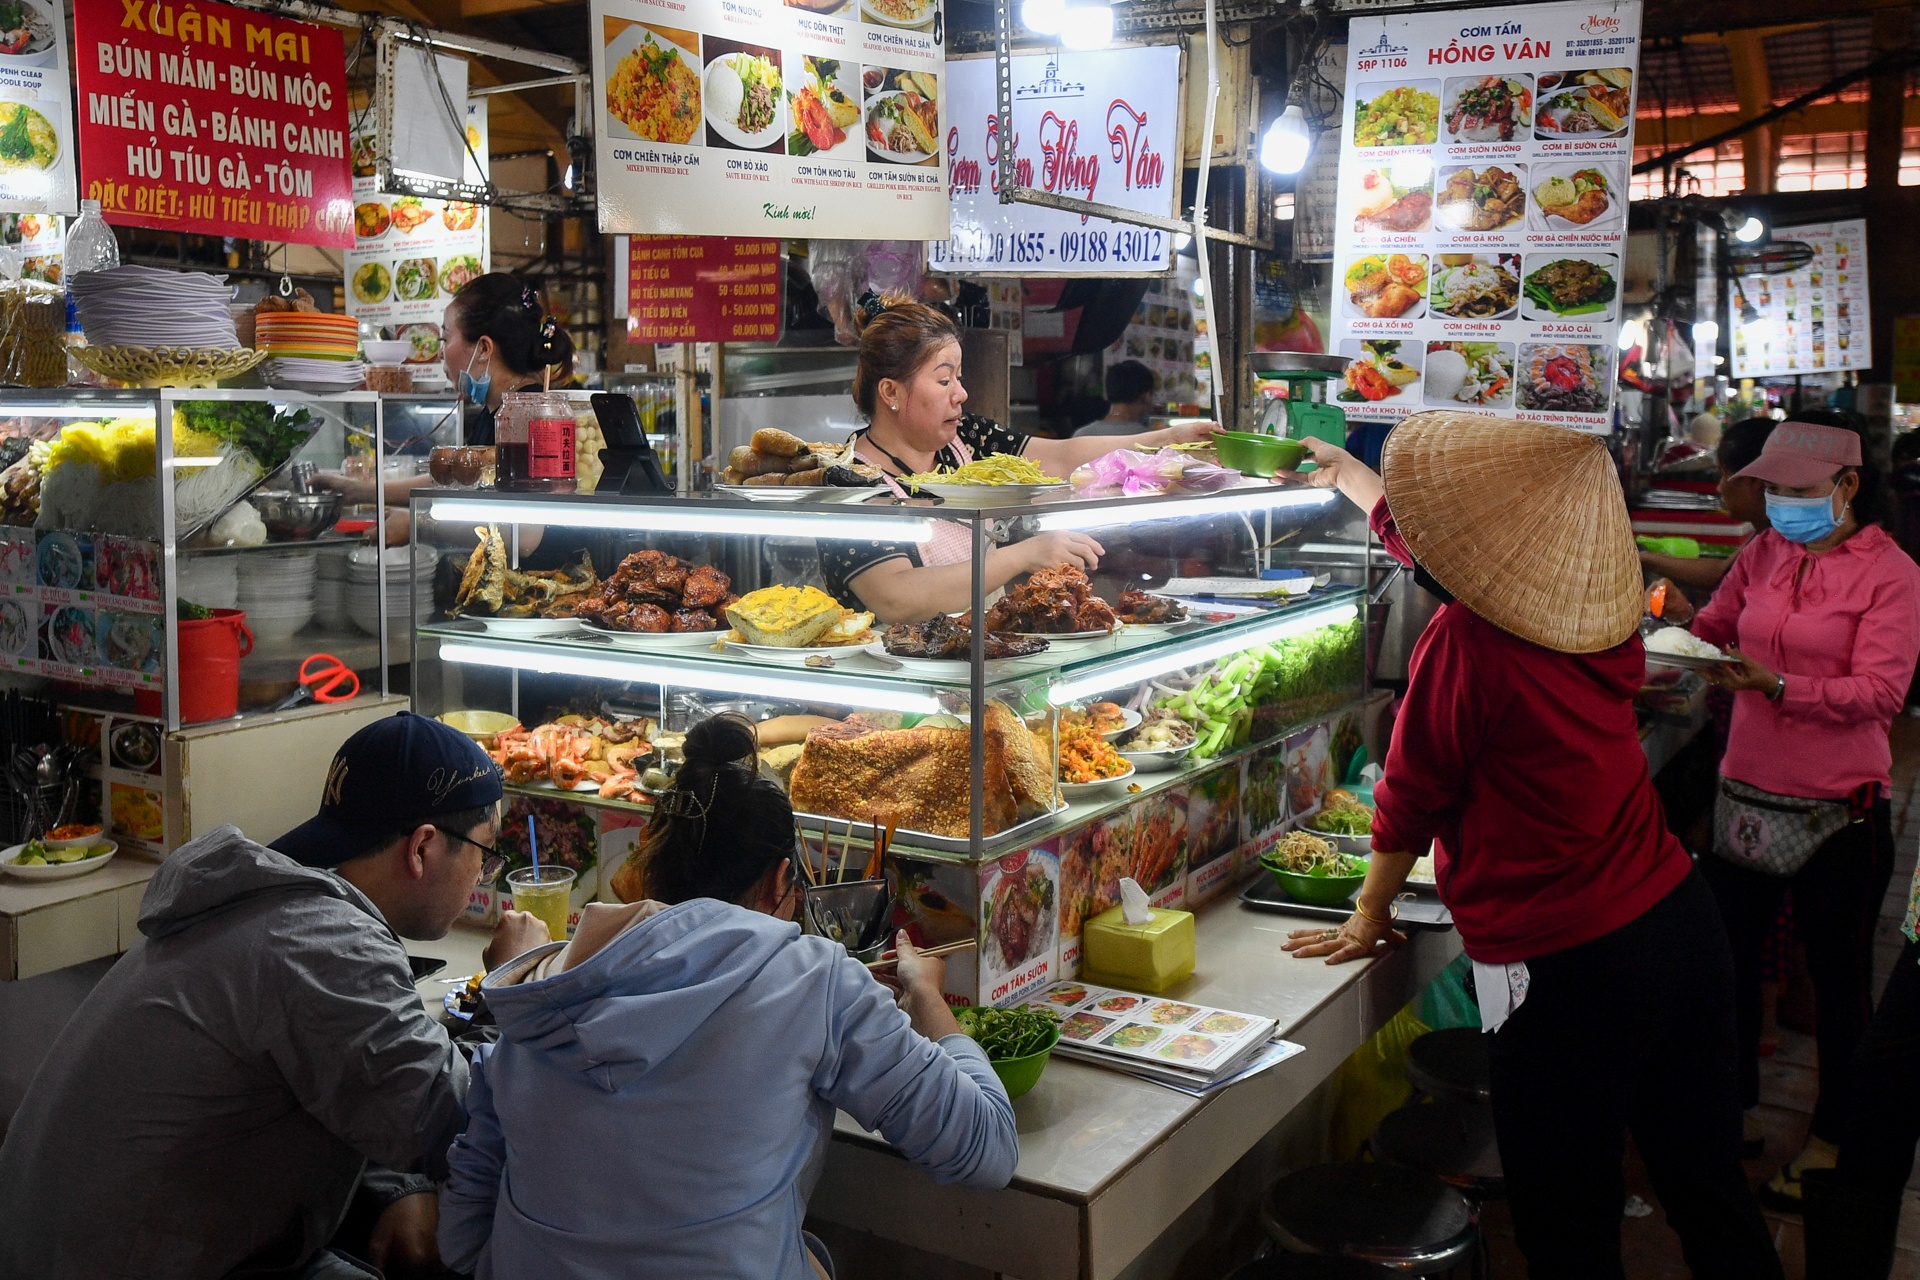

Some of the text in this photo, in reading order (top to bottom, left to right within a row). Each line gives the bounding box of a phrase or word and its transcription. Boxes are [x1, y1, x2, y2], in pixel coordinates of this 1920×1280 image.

[121, 0, 311, 64] XUÂN MAI
[1460, 21, 1522, 39] CƠM TẤM
[868, 31, 882, 42] CƠM
[883, 33, 903, 45] CHIÊN
[1428, 37, 1552, 66] HỒNG VÂN
[1358, 57, 1407, 73] SẠP 1106
[21, 69, 43, 79] CLEAR
[98, 38, 151, 81] BÚN
[284, 72, 333, 117] MỘC
[23, 79, 42, 88] SOUP
[88, 89, 156, 132] MIẾN
[283, 122, 345, 159] CANH
[1107, 98, 1164, 191] Vân
[1447, 143, 1522, 154] CƠM SƯỜN NƯỚNG
[1542, 143, 1562, 151] CƠM
[127, 137, 163, 180] HỦ
[170, 146, 211, 186] TÍU
[613, 149, 633, 161] CƠM
[634, 149, 660, 163] CHIÊN
[661, 151, 682, 166] THẬP
[626, 164, 690, 176] MIXED WITH FRIED RICE
[726, 159, 769, 172] CƠM BÒ XÀO
[797, 166, 856, 179] CƠM TÔM KHO TÀU
[868, 171, 883, 181] CƠM
[189, 188, 215, 219] HỦ
[222, 192, 261, 225] TIẾU
[267, 200, 310, 234] THẬP
[1393, 234, 1417, 243] CHIÊN
[1452, 234, 1505, 243] CƠM GÀ KHO
[1526, 234, 1545, 242] CƠM
[1545, 234, 1556, 242] GÀ
[1557, 233, 1579, 242] CHIÊN
[1009, 232, 1045, 263] 1855
[1060, 231, 1109, 263] 09188
[1112, 230, 1162, 263] 43012
[733, 284, 759, 296] 60.000
[733, 324, 759, 336] 60.000
[1353, 321, 1371, 329] CƠM
[1464, 321, 1488, 331] CHIÊN
[1489, 321, 1501, 331] BÒ
[1542, 323, 1592, 333] BÒ XÀO CẢI
[1362, 405, 1378, 413] TÔM
[1397, 407, 1412, 415] TÀU
[1516, 412, 1526, 420] BÒ
[1526, 413, 1542, 421] XÀO
[1584, 416, 1606, 424] SALAD
[991, 982, 1009, 1001] CƠM
[1028, 960, 1048, 982] SƯỜN
